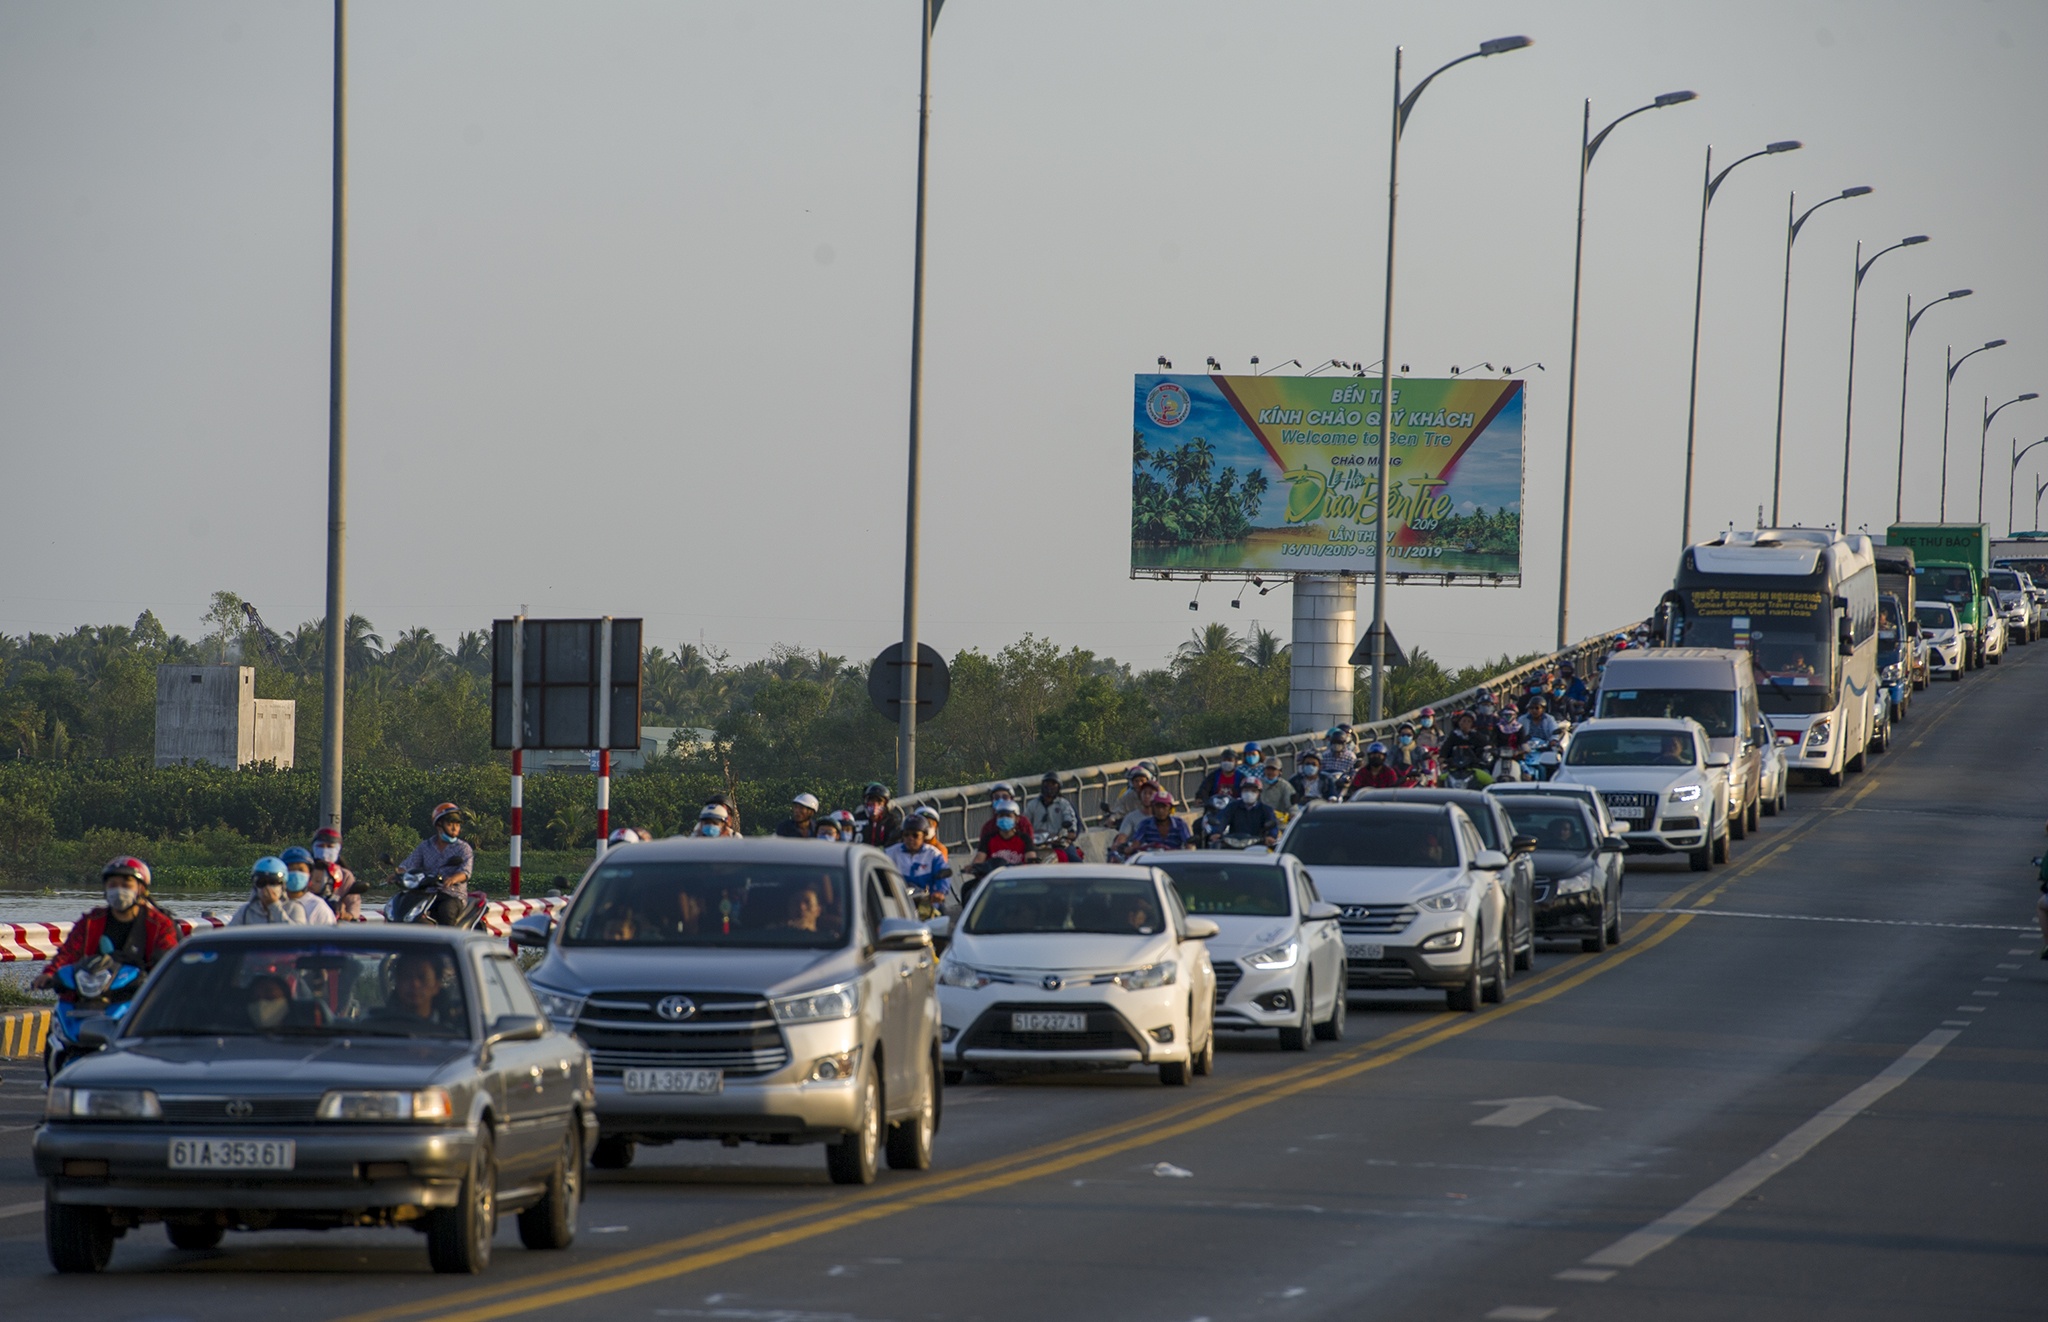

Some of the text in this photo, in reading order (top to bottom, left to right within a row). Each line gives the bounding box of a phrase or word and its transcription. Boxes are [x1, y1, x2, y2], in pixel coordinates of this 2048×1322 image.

[1331, 383, 1366, 404] BẾN
[1258, 405, 1475, 427] KÍNH CHÀO QÝ KHÁCH
[1281, 429, 1359, 445] Welcome
[1363, 431, 1380, 445] to
[1423, 431, 1453, 446] Tre
[1331, 454, 1365, 466] CHÀO
[1404, 473, 1454, 529] Tre
[1412, 518, 1439, 531] 2019
[1328, 525, 1355, 542] LẦN
[1902, 537, 1917, 547] XE
[1919, 537, 1943, 547] THƯ
[1281, 543, 1358, 558] 16/11/2019
[1366, 544, 1443, 560] 2/11/2019
[1698, 608, 1746, 617] Cambodia
